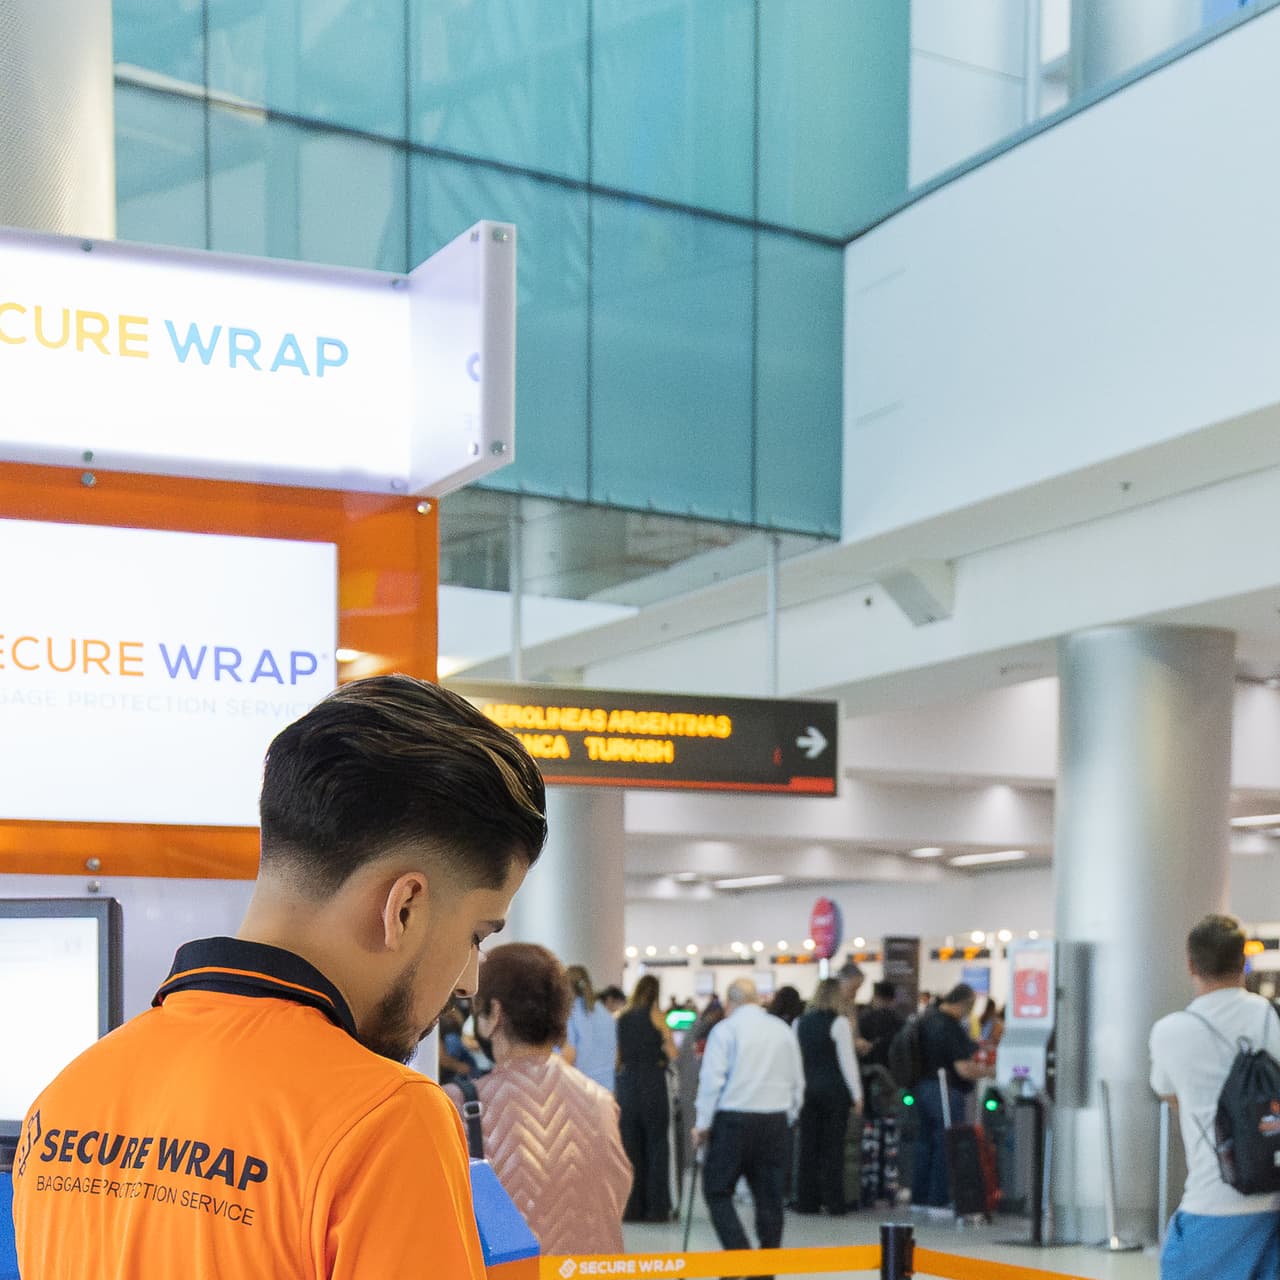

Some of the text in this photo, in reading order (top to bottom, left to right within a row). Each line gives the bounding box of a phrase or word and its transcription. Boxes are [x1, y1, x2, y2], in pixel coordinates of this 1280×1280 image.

[164, 319, 349, 378] WRAP
[159, 642, 319, 686] WRAP
[68, 690, 217, 715] PROTECTION
[584, 736, 675, 763] TURKISH
[40, 1129, 268, 1191] SECURE WRAP
[36, 1176, 101, 1195] BAGGAGE
[180, 1190, 255, 1226] SERVICE
[579, 1258, 686, 1274] SECURE WRAP
